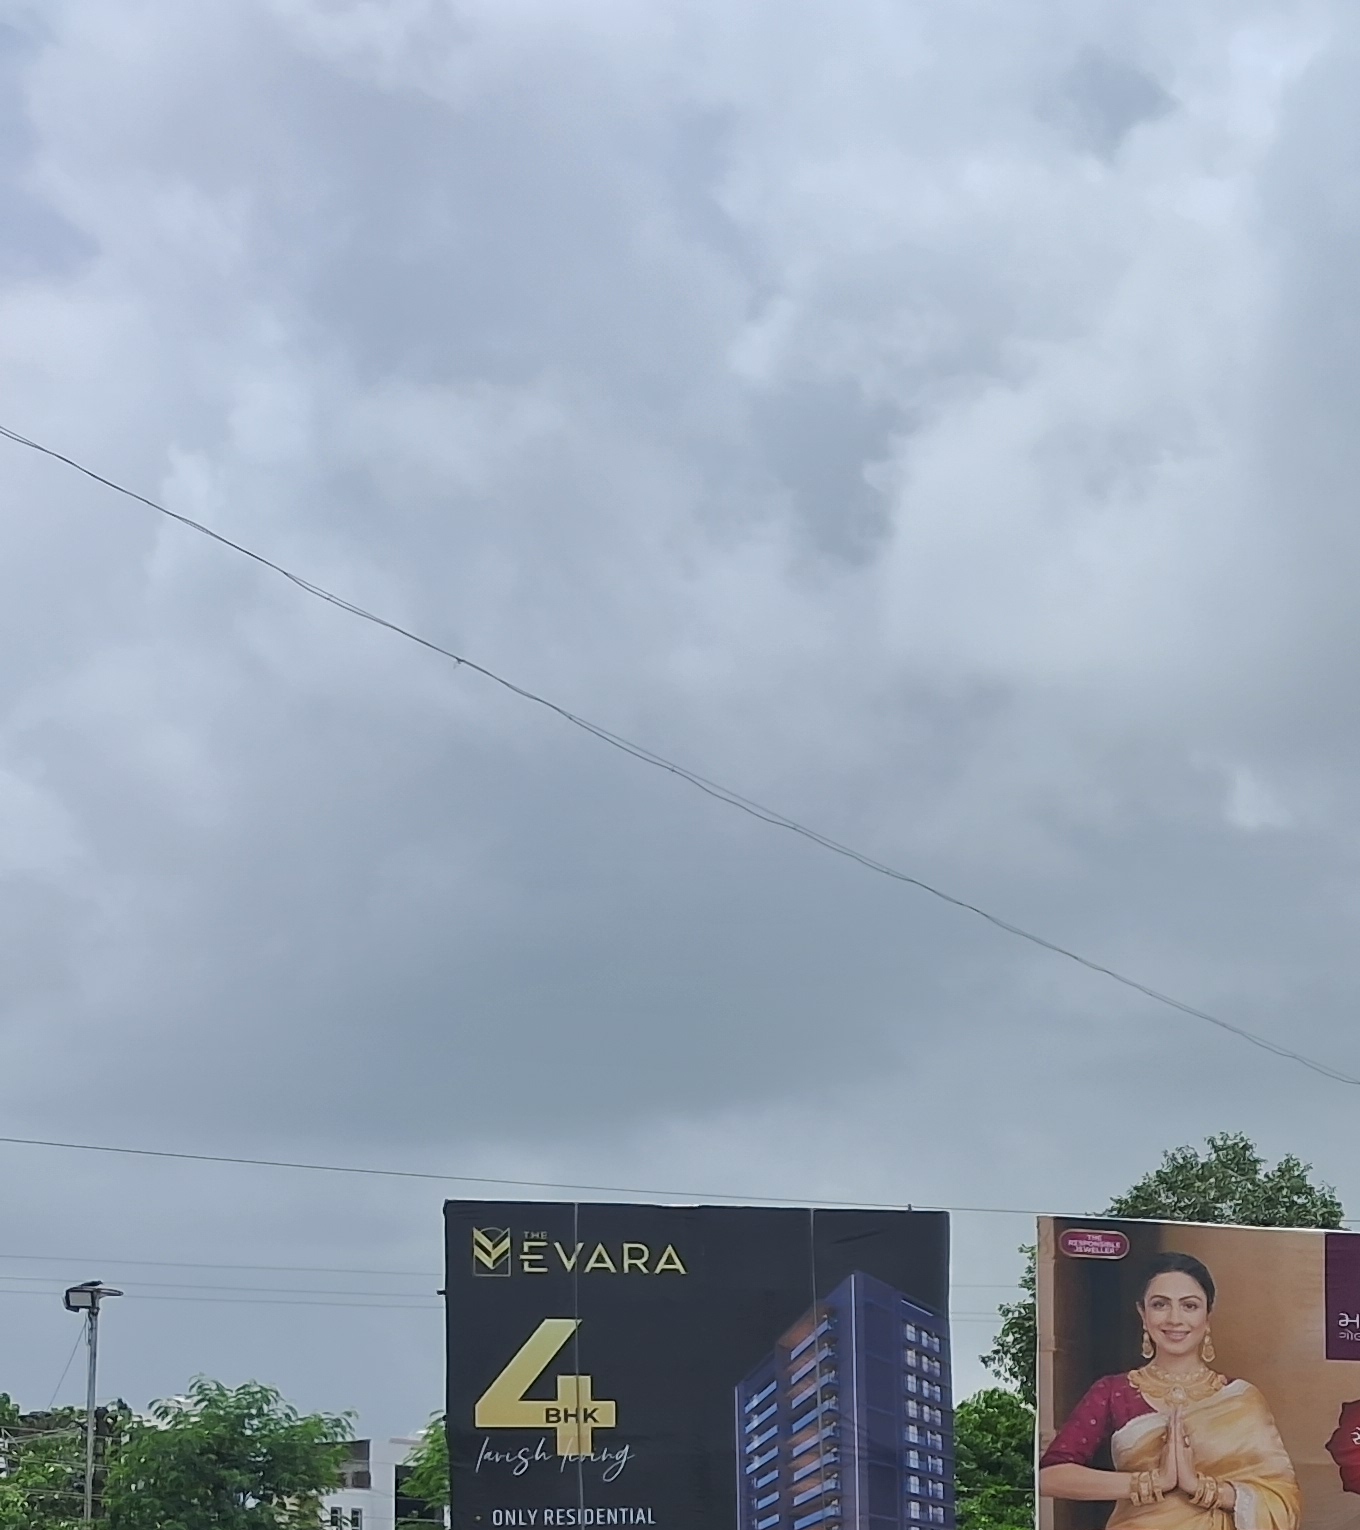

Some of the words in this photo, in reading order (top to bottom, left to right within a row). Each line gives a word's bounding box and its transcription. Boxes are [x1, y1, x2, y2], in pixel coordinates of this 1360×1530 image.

[523, 1231, 548, 1239] THE
[519, 1241, 689, 1275] EVARA
[475, 1318, 617, 1456] 4
[545, 1407, 600, 1424] BHK
[475, 1437, 553, 1476] lavish
[492, 1509, 538, 1526] ONLY
[544, 1507, 656, 1526] RESIDENTIAL
